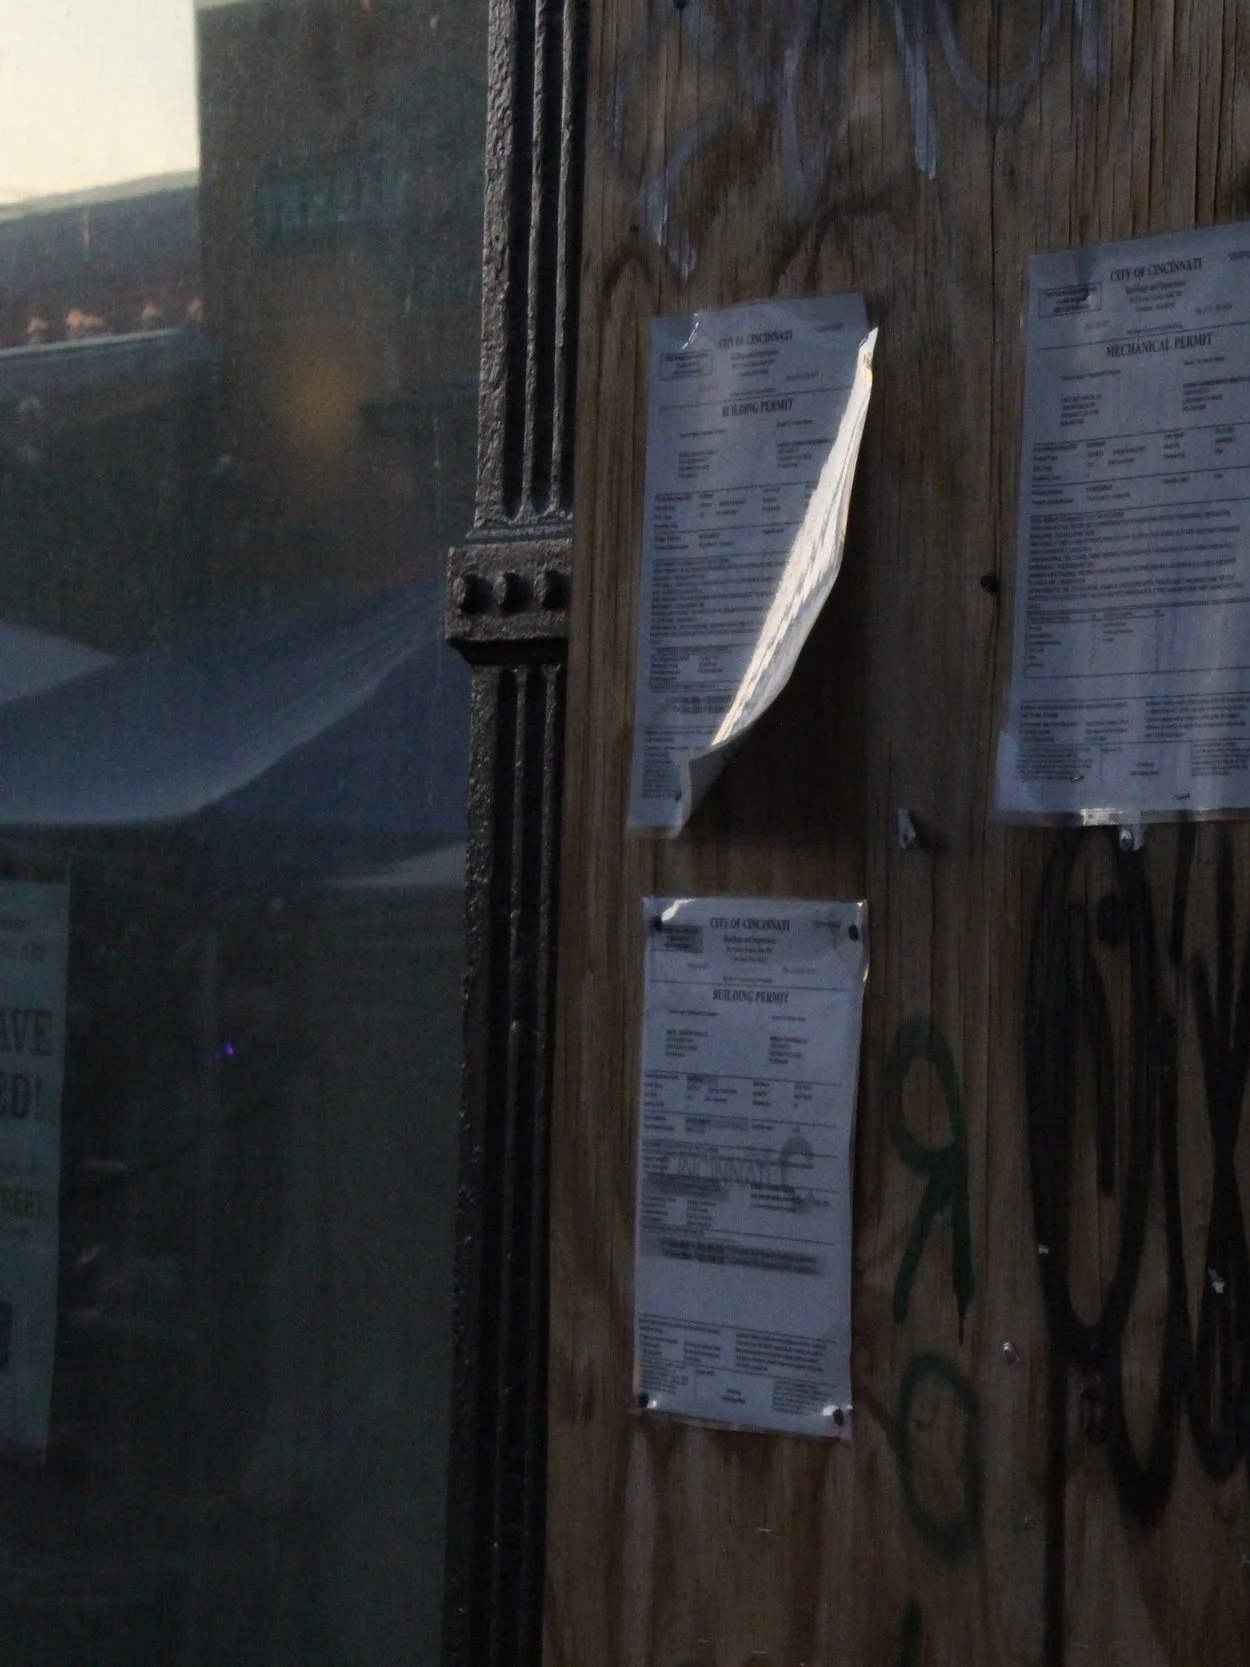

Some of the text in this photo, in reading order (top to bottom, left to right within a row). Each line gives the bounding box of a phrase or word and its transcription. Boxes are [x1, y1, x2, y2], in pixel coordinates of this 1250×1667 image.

[1110, 256, 1203, 282] CITY OF CINCINNATI
[717, 339, 734, 350] CITY
[746, 329, 793, 346] CINCINNATI
[1106, 332, 1213, 358] MECHANICAL PERMIT
[721, 398, 794, 418] BUILDING PERMIT
[709, 917, 791, 931] CITY OF CINCINNATI
[712, 987, 790, 1006] BUILDING PERMIT
